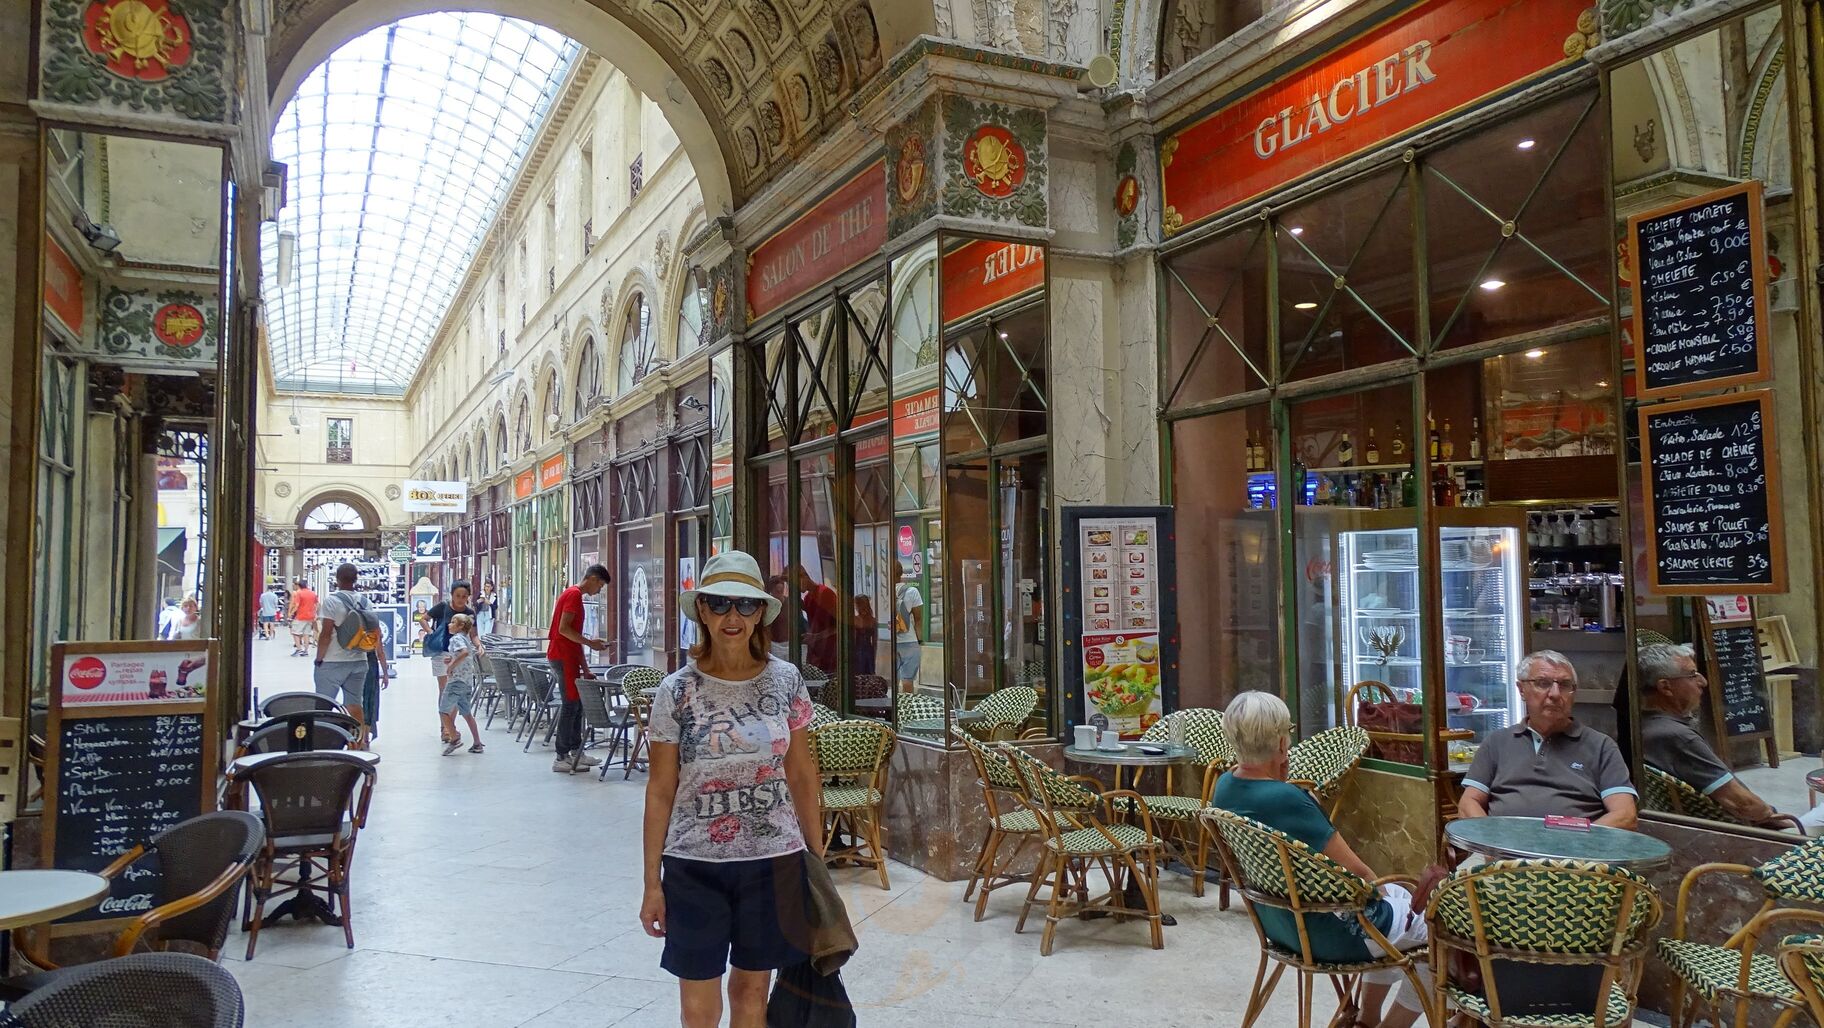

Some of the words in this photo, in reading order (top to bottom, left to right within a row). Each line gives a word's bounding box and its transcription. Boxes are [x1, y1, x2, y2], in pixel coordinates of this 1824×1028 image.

[1255, 40, 1437, 158] GLACIER
[762, 240, 806, 292] SALON
[812, 223, 832, 261] DE
[1651, 264, 1697, 285] OMELETTE
[1659, 450, 1694, 464] SALADE
[1700, 448, 1713, 460] DE
[1706, 484, 1730, 494] DUO
[1666, 557, 1699, 570] SALADE
[1702, 556, 1735, 569] VERTE
